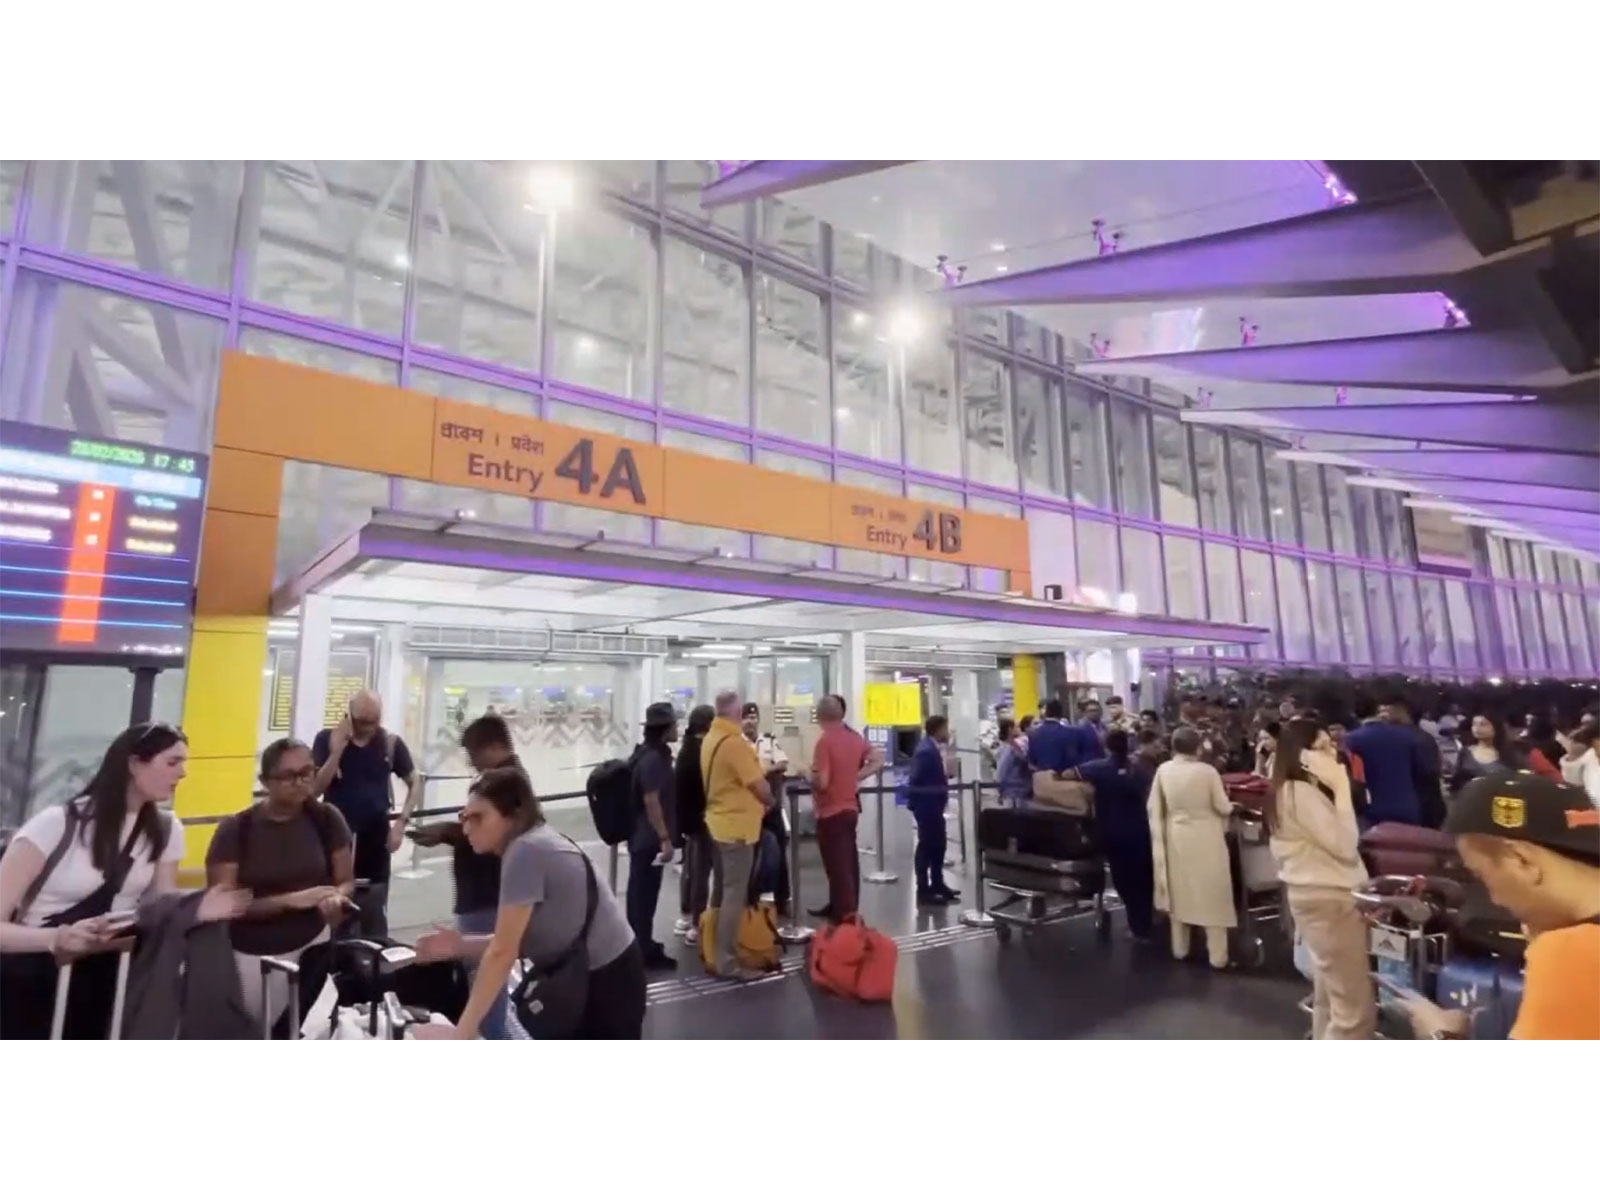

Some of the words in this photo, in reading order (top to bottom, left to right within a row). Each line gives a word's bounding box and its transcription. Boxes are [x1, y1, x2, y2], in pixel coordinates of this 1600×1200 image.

[468, 453, 544, 492] Entry
[555, 438, 646, 505] 4A
[866, 524, 907, 551] Entry
[912, 509, 962, 554] 4B
